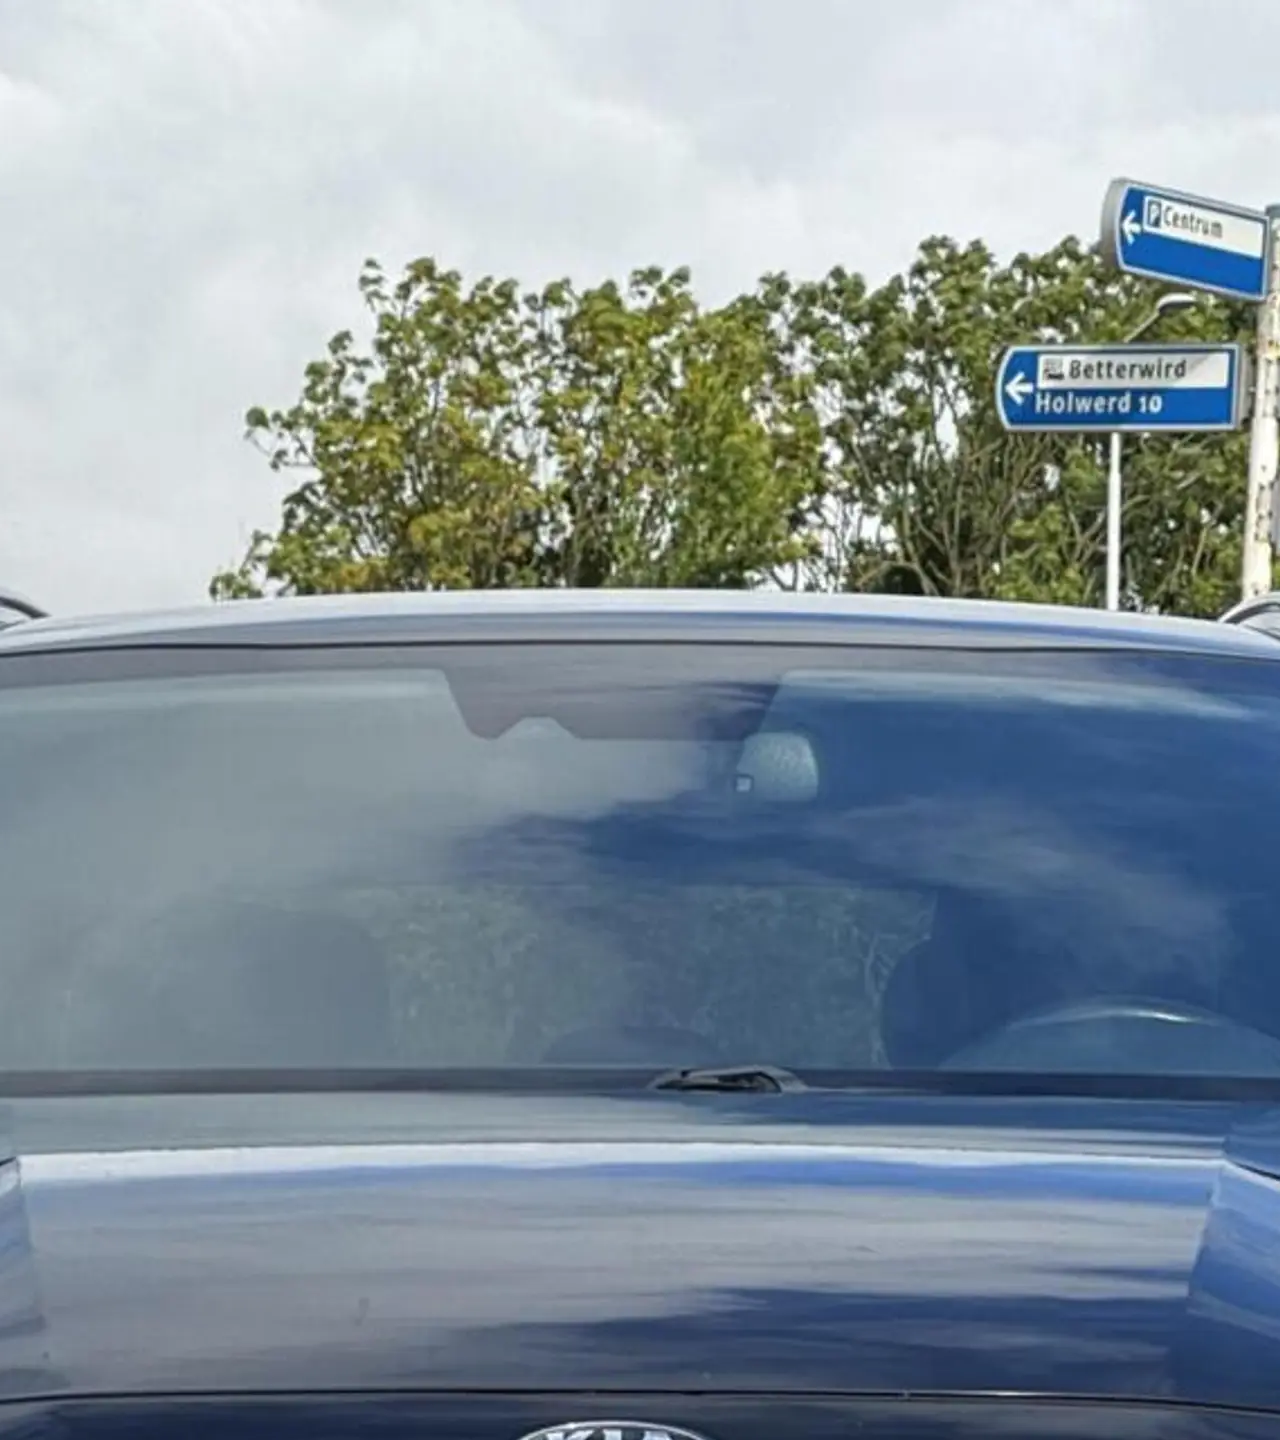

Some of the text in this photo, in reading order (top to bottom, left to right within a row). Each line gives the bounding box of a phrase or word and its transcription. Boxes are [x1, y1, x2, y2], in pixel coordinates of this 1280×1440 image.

[1163, 205, 1223, 239] Centrum
[1069, 360, 1187, 380] Betterwird
[1034, 392, 1163, 414] Holwerd 10
